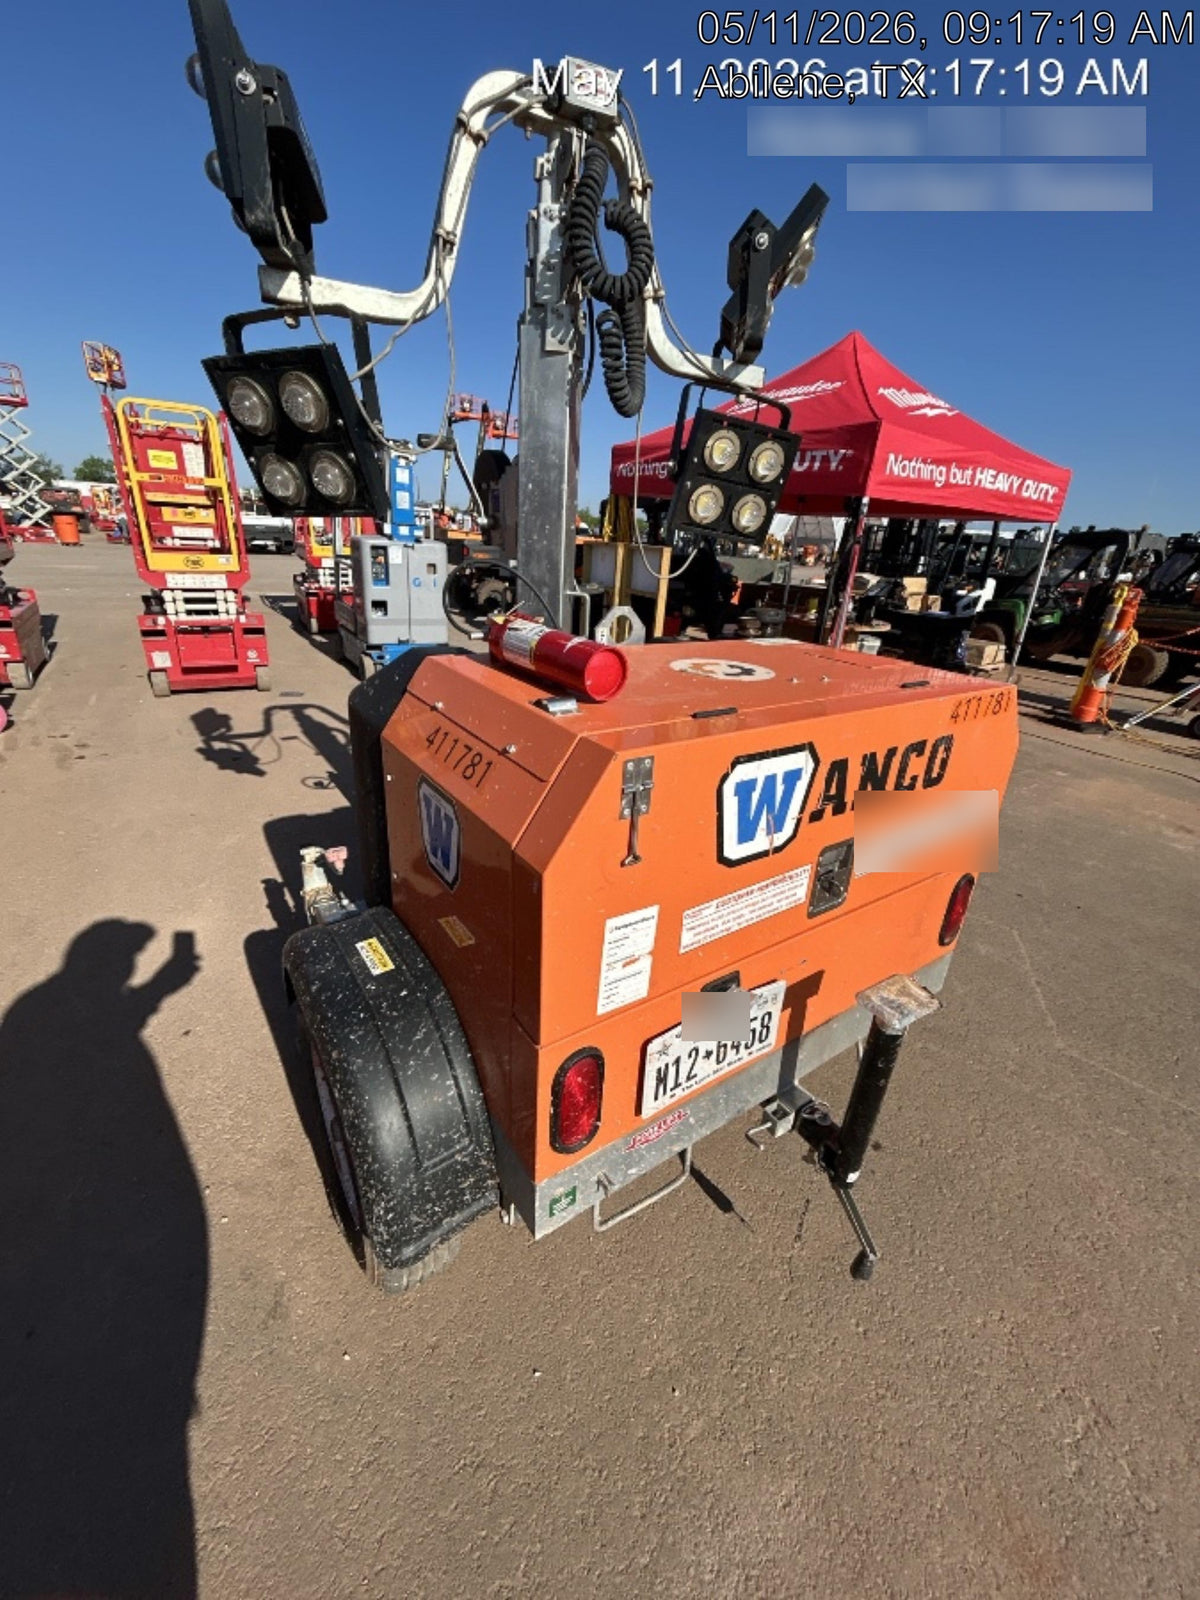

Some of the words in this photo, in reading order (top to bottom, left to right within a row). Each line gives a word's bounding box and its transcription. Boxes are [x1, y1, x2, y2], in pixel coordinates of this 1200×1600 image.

[615, 459, 668, 479] Nohing
[885, 453, 946, 488] Nothing
[949, 461, 973, 487] but
[974, 466, 1023, 496] HEAVY
[949, 690, 1012, 724] 411781
[425, 725, 494, 788] 411781
[733, 733, 954, 845] WANCO
[422, 792, 454, 873] W
